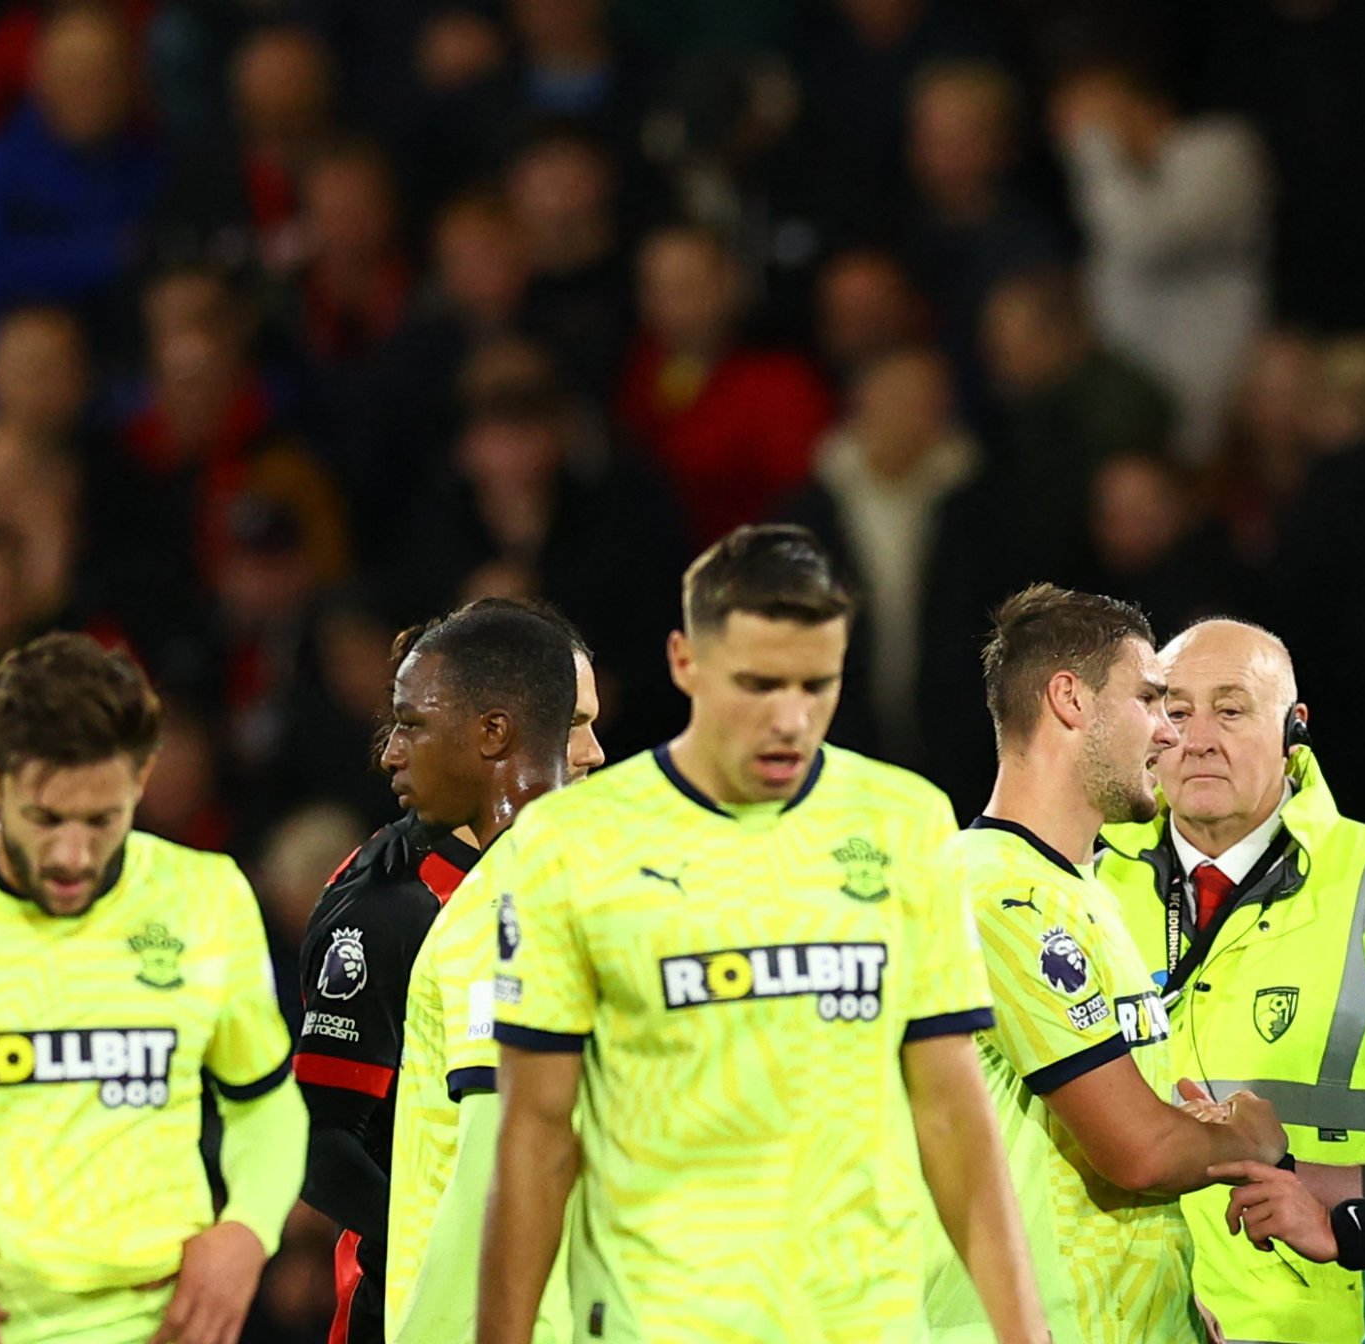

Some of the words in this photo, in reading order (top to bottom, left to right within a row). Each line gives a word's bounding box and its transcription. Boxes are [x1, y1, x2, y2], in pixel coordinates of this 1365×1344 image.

[663, 945, 885, 1006] ROLLBIT
[317, 1012, 356, 1030] room
[314, 1024, 360, 1042] racism
